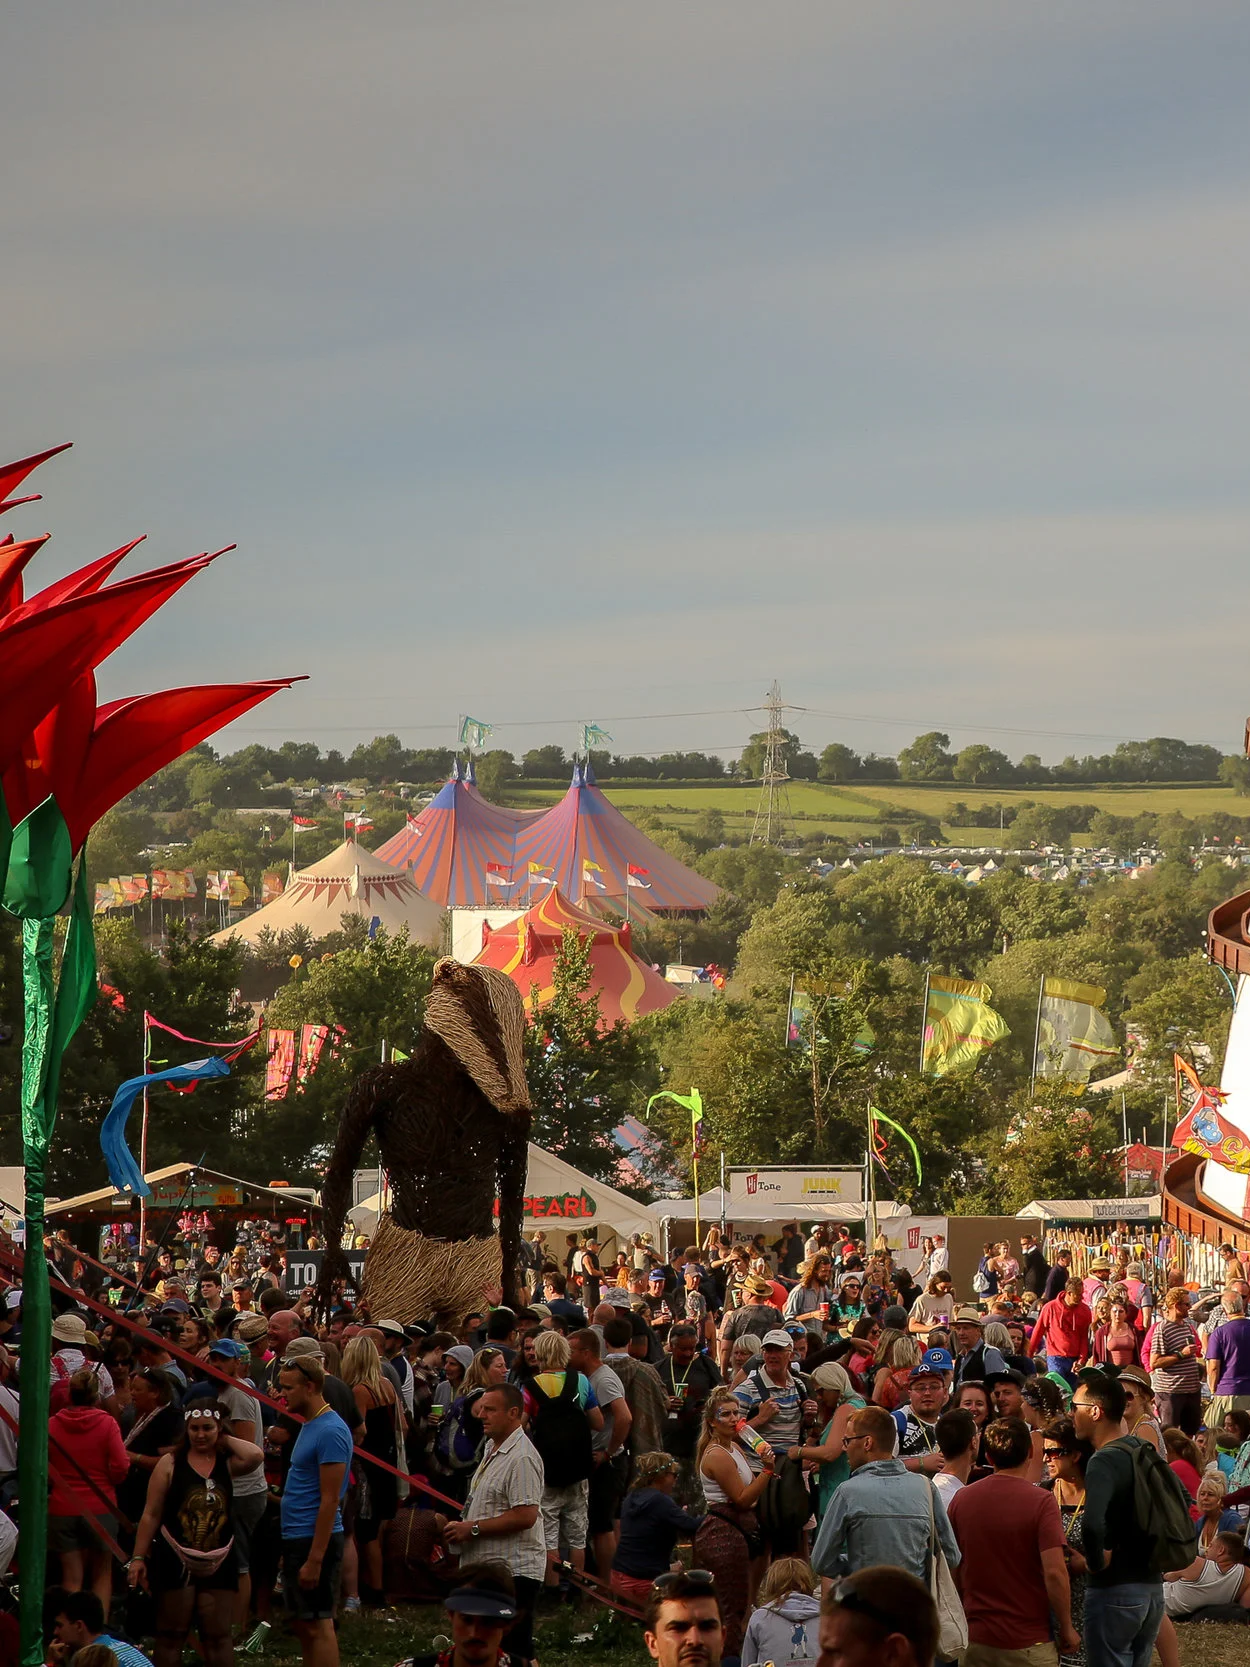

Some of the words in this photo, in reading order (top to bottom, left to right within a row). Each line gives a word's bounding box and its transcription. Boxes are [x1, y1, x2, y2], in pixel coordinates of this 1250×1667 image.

[747, 1176, 757, 1193] Hi
[758, 1181, 781, 1191] Tone
[801, 1178, 842, 1193] JUNK
[523, 1197, 593, 1217] PEARL
[734, 1231, 754, 1242] Ton
[910, 1230, 919, 1247] Hi
